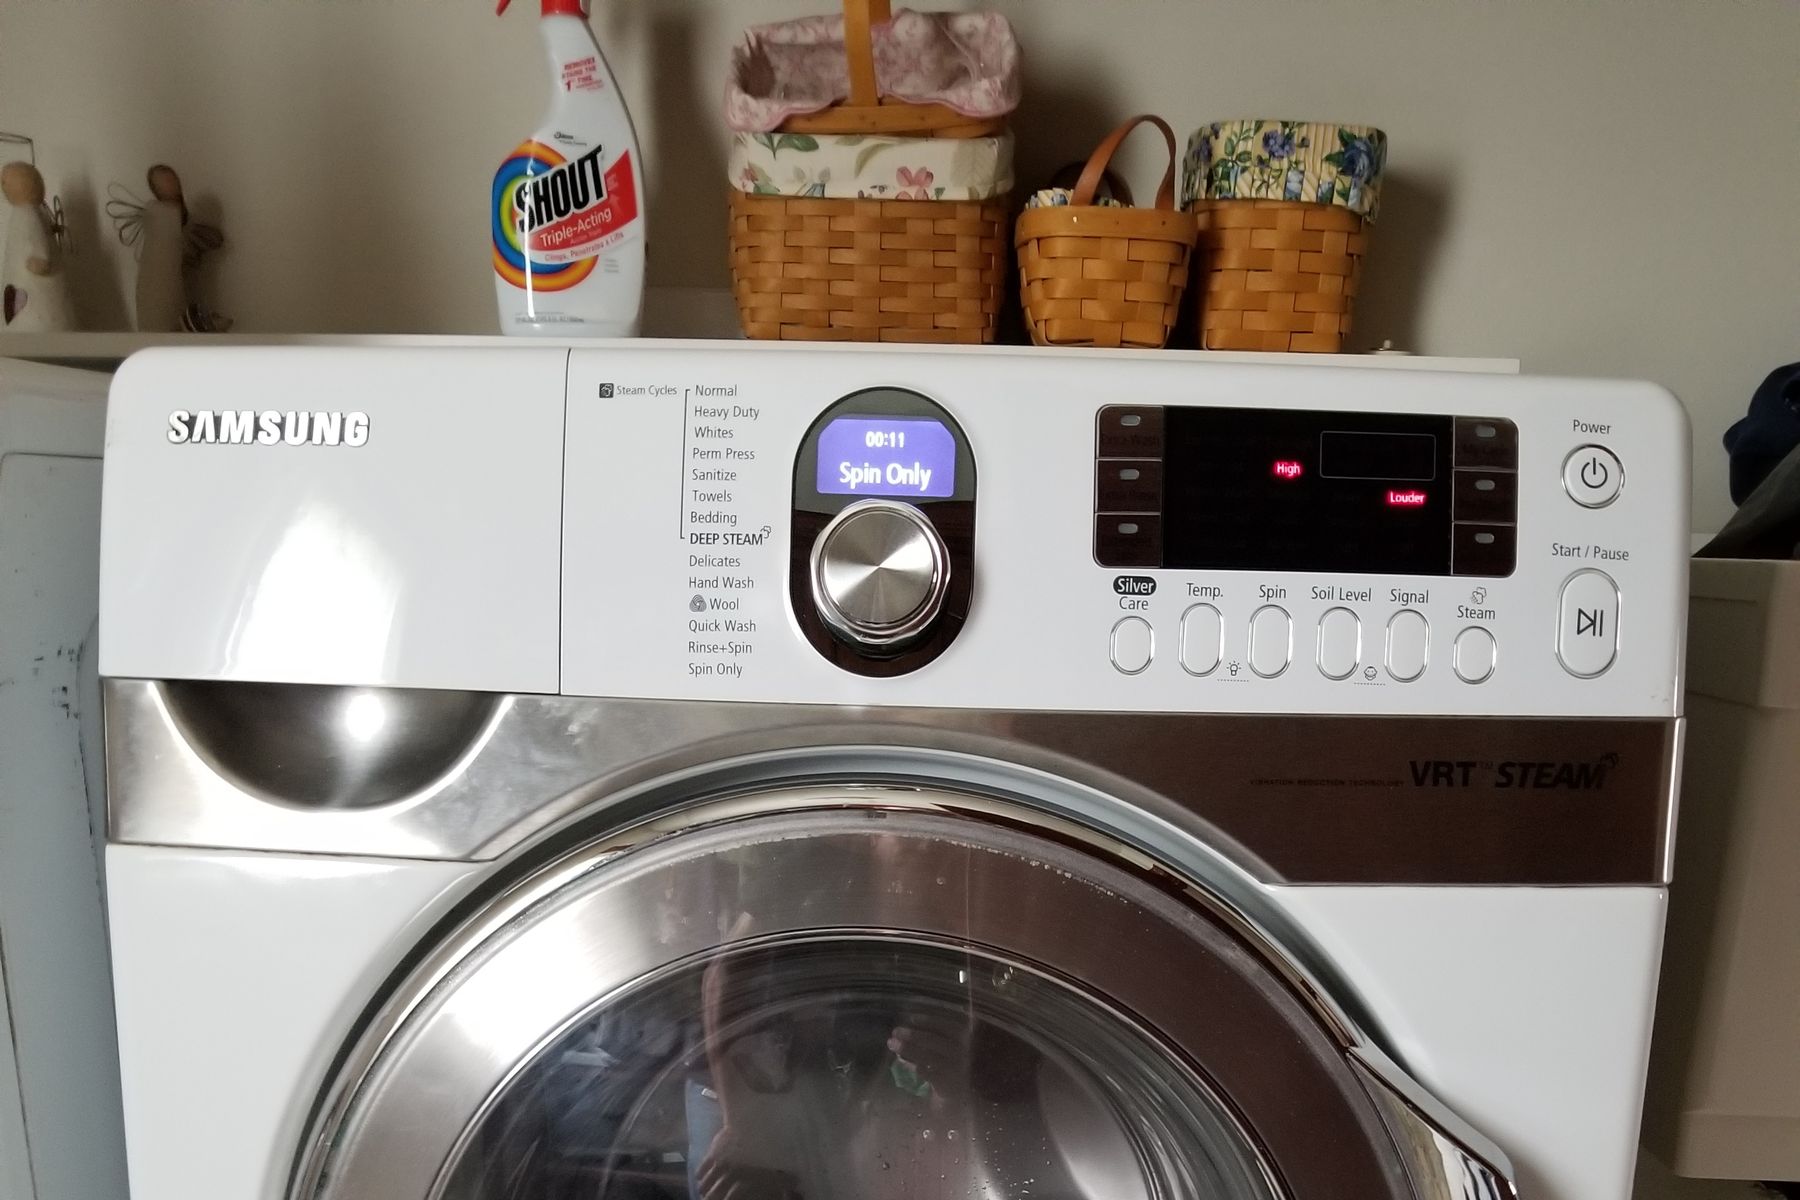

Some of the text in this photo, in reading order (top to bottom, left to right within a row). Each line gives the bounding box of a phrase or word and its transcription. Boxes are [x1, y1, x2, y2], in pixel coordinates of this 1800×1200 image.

[516, 144, 603, 233] SHOUT
[540, 207, 612, 247] Triple-Acting
[616, 385, 678, 398] Steam Cycles
[695, 384, 738, 397] Normal
[694, 405, 760, 420] Heavy Duty
[167, 410, 371, 447] SAMSUNG
[694, 426, 734, 439] Whites
[1573, 419, 1612, 435] Power
[865, 431, 905, 448] 00:11
[692, 447, 756, 460] Perm Press
[692, 468, 737, 481] Sanitize
[839, 461, 932, 491] Spin Only
[1276, 462, 1301, 477] High
[692, 489, 733, 503] Towels
[1390, 491, 1425, 504] Louder
[690, 510, 737, 527] Bedding
[689, 532, 763, 546] DEEP STEAM
[1551, 543, 1630, 561] Start / Pause
[689, 554, 741, 567] Delicates
[688, 576, 754, 589] Hand Wash
[1117, 578, 1154, 594] Silver
[1186, 582, 1224, 600] Temp.
[1259, 584, 1287, 602] Spin
[1311, 586, 1372, 602] Soil Level
[1390, 588, 1429, 607] Signal
[709, 598, 740, 611] Wool
[1119, 596, 1149, 610] Care
[1457, 605, 1496, 620] Steam
[688, 620, 757, 633] Quick Wash
[688, 641, 753, 656] Rinse+Spin
[688, 662, 743, 678] Spin Only
[1495, 761, 1605, 790] STEAM
